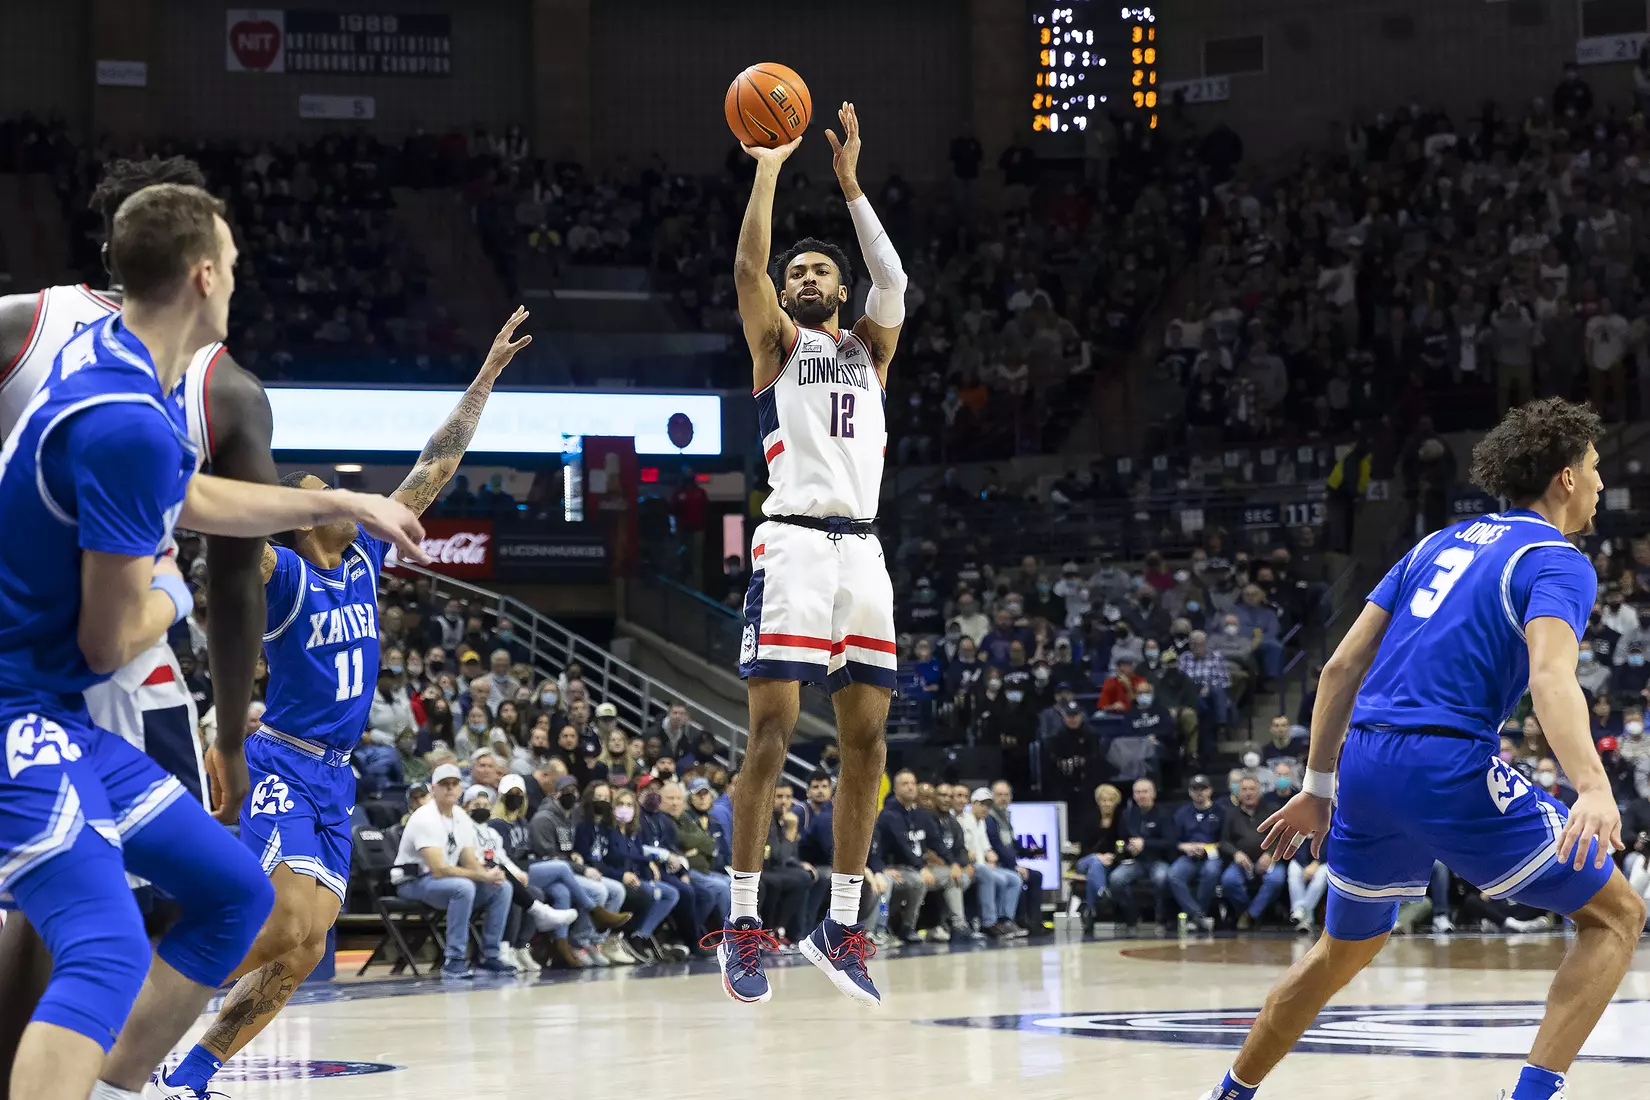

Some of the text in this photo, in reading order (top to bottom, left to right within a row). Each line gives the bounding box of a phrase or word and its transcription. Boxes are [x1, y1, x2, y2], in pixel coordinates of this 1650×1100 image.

[237, 33, 273, 52] NIT
[769, 84, 800, 130] ELITE
[830, 392, 856, 438] 12
[1243, 503, 1323, 525] SEC 113
[1453, 499, 1483, 514] SEC
[1455, 522, 1511, 545] JONES
[1410, 547, 1474, 619] 3
[334, 648, 364, 702] 11
